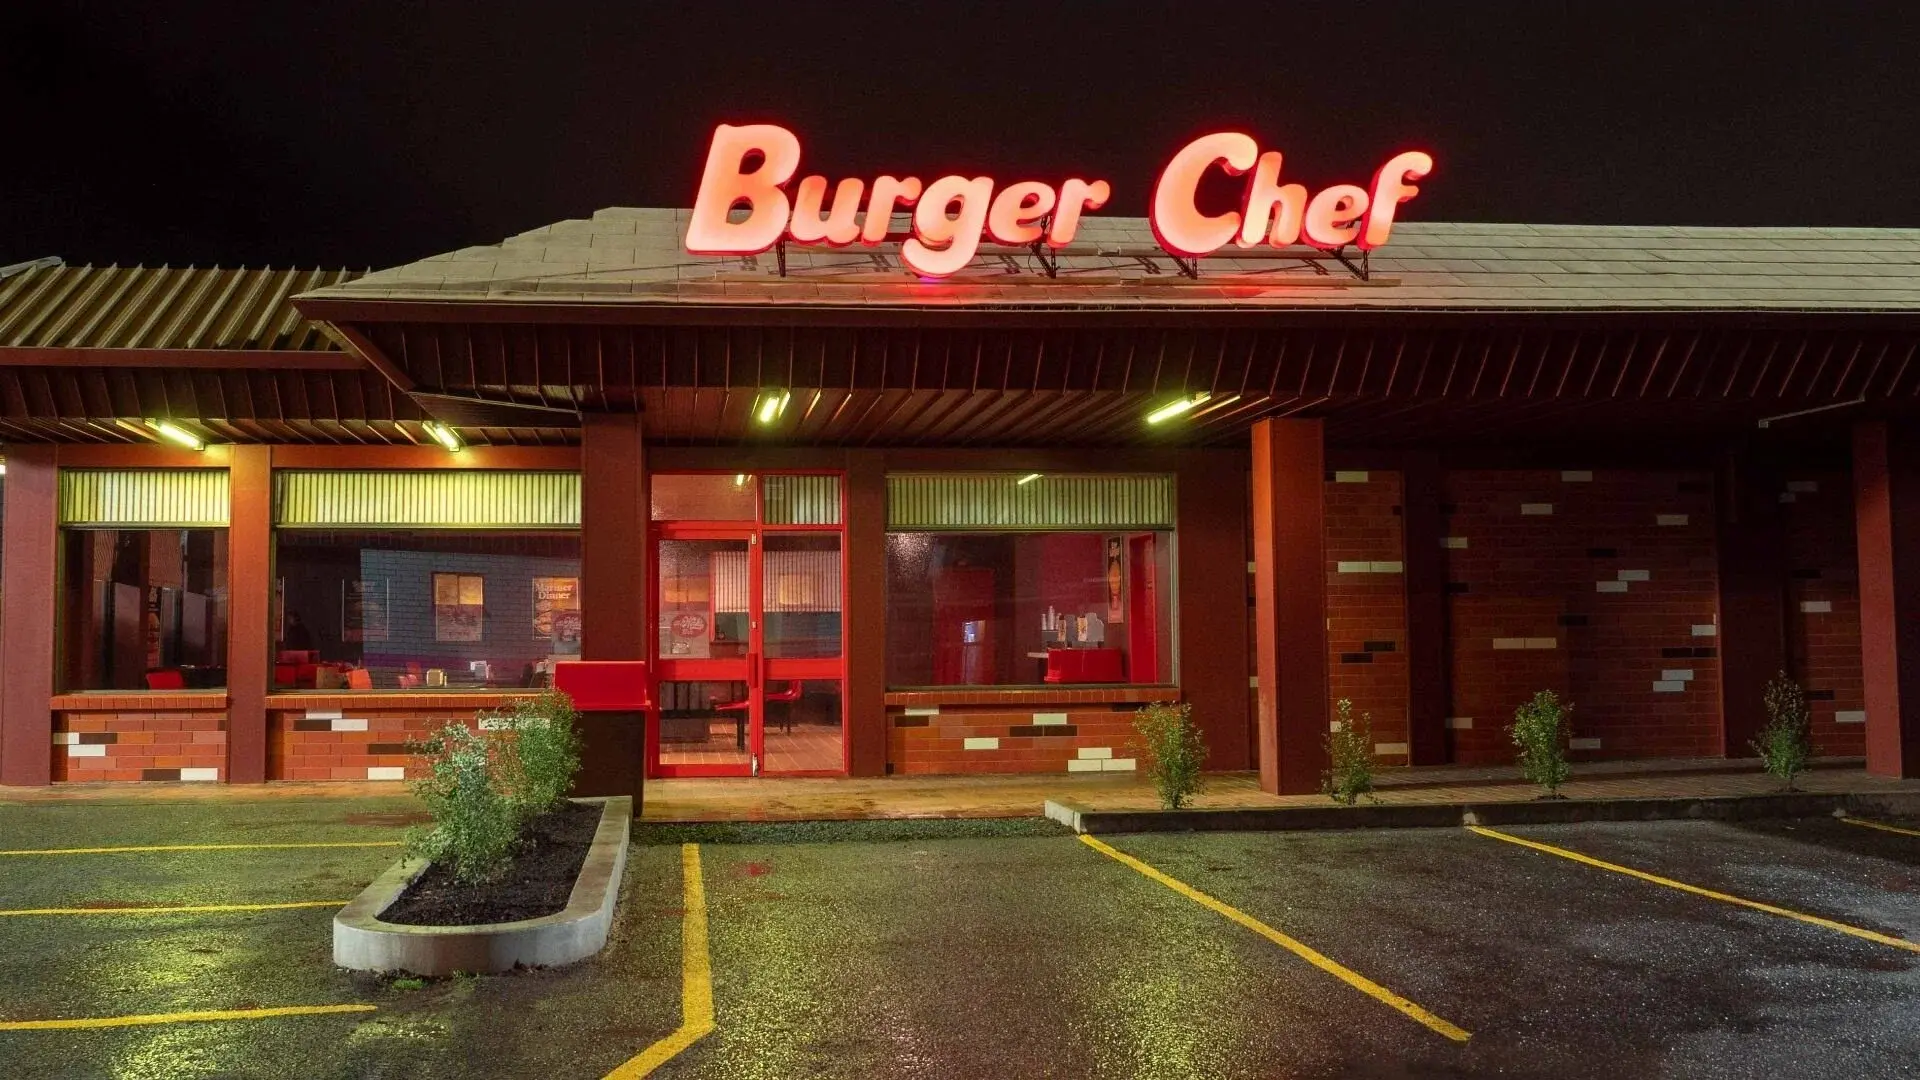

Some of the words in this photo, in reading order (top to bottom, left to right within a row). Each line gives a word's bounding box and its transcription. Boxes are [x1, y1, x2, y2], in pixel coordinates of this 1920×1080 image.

[685, 123, 1110, 279] Burger
[1150, 131, 1434, 257] Chef
[538, 591, 571, 600] Dinner
